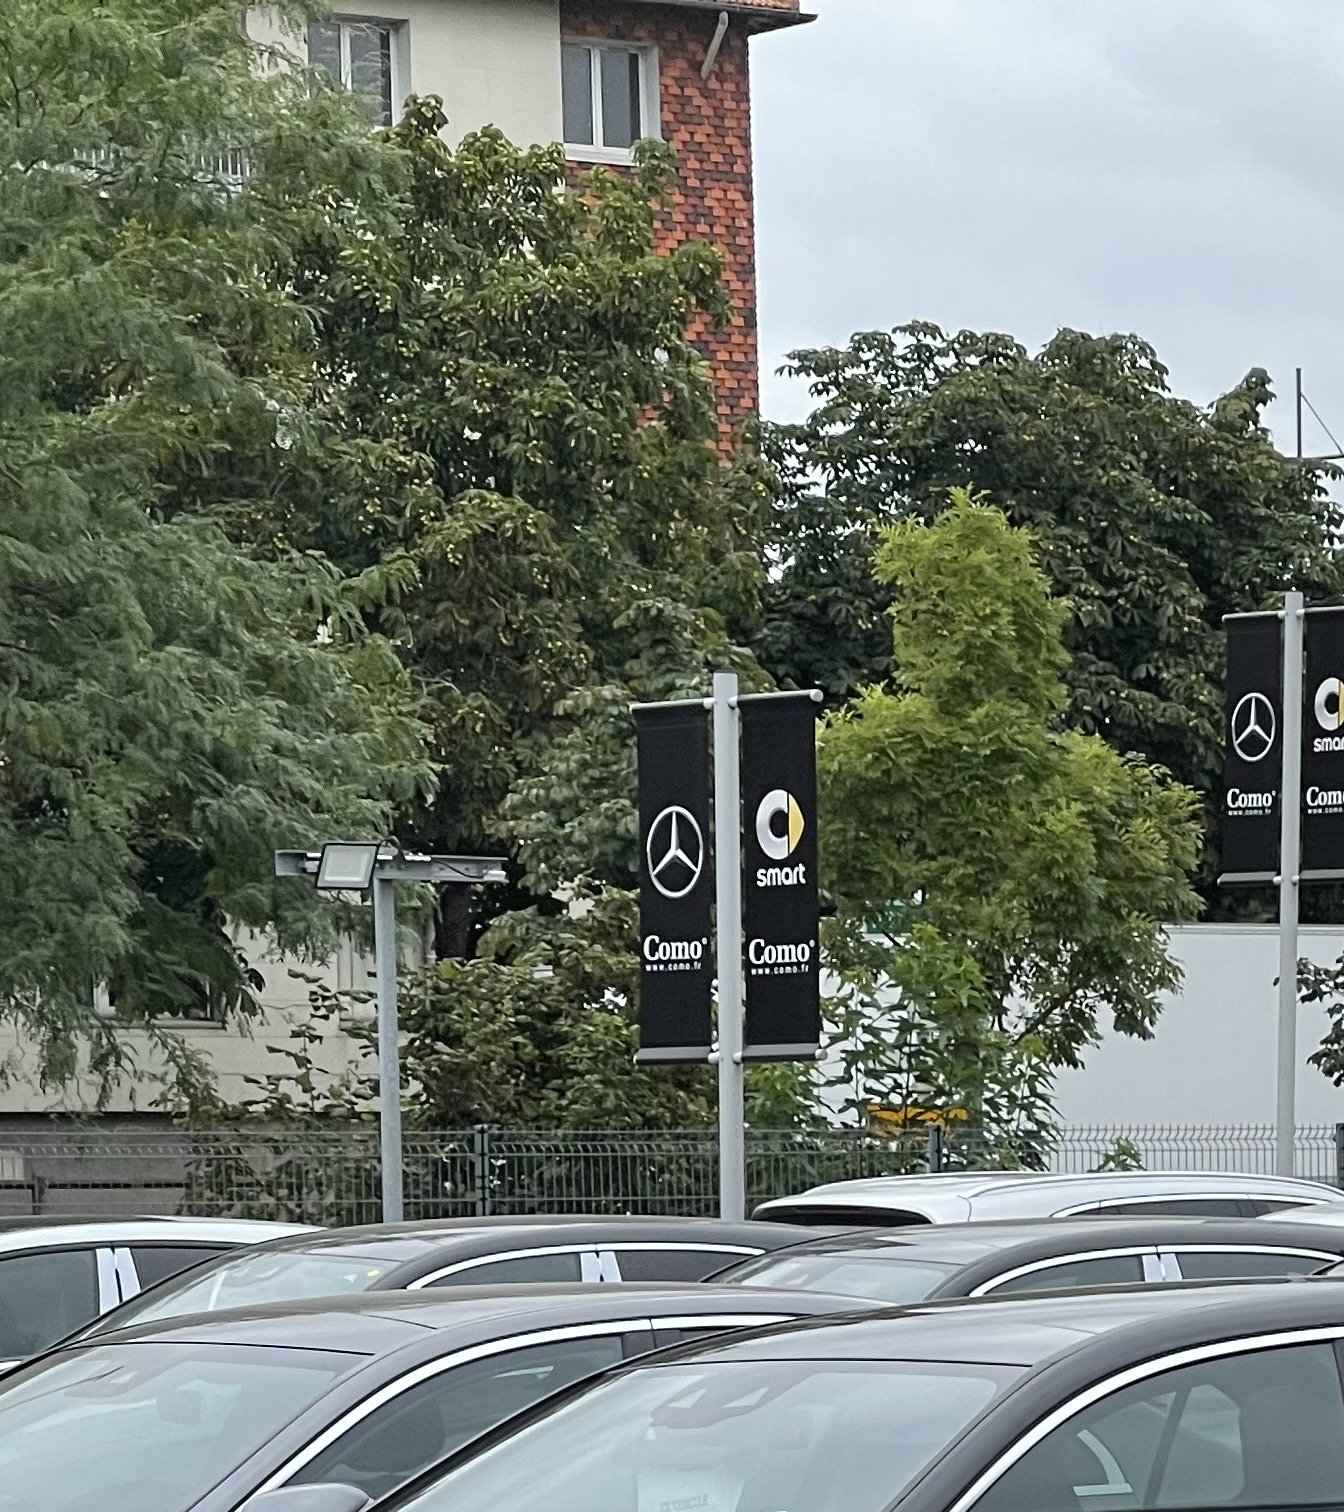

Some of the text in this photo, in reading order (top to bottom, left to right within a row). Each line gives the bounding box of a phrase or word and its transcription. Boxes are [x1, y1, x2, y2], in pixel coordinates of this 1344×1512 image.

[1226, 788, 1273, 808] Como
[756, 863, 806, 887] smart
[643, 934, 703, 961] Como
[749, 938, 811, 965] Como
[645, 961, 702, 972] www.como.fr
[750, 964, 809, 976] www.como.fr
